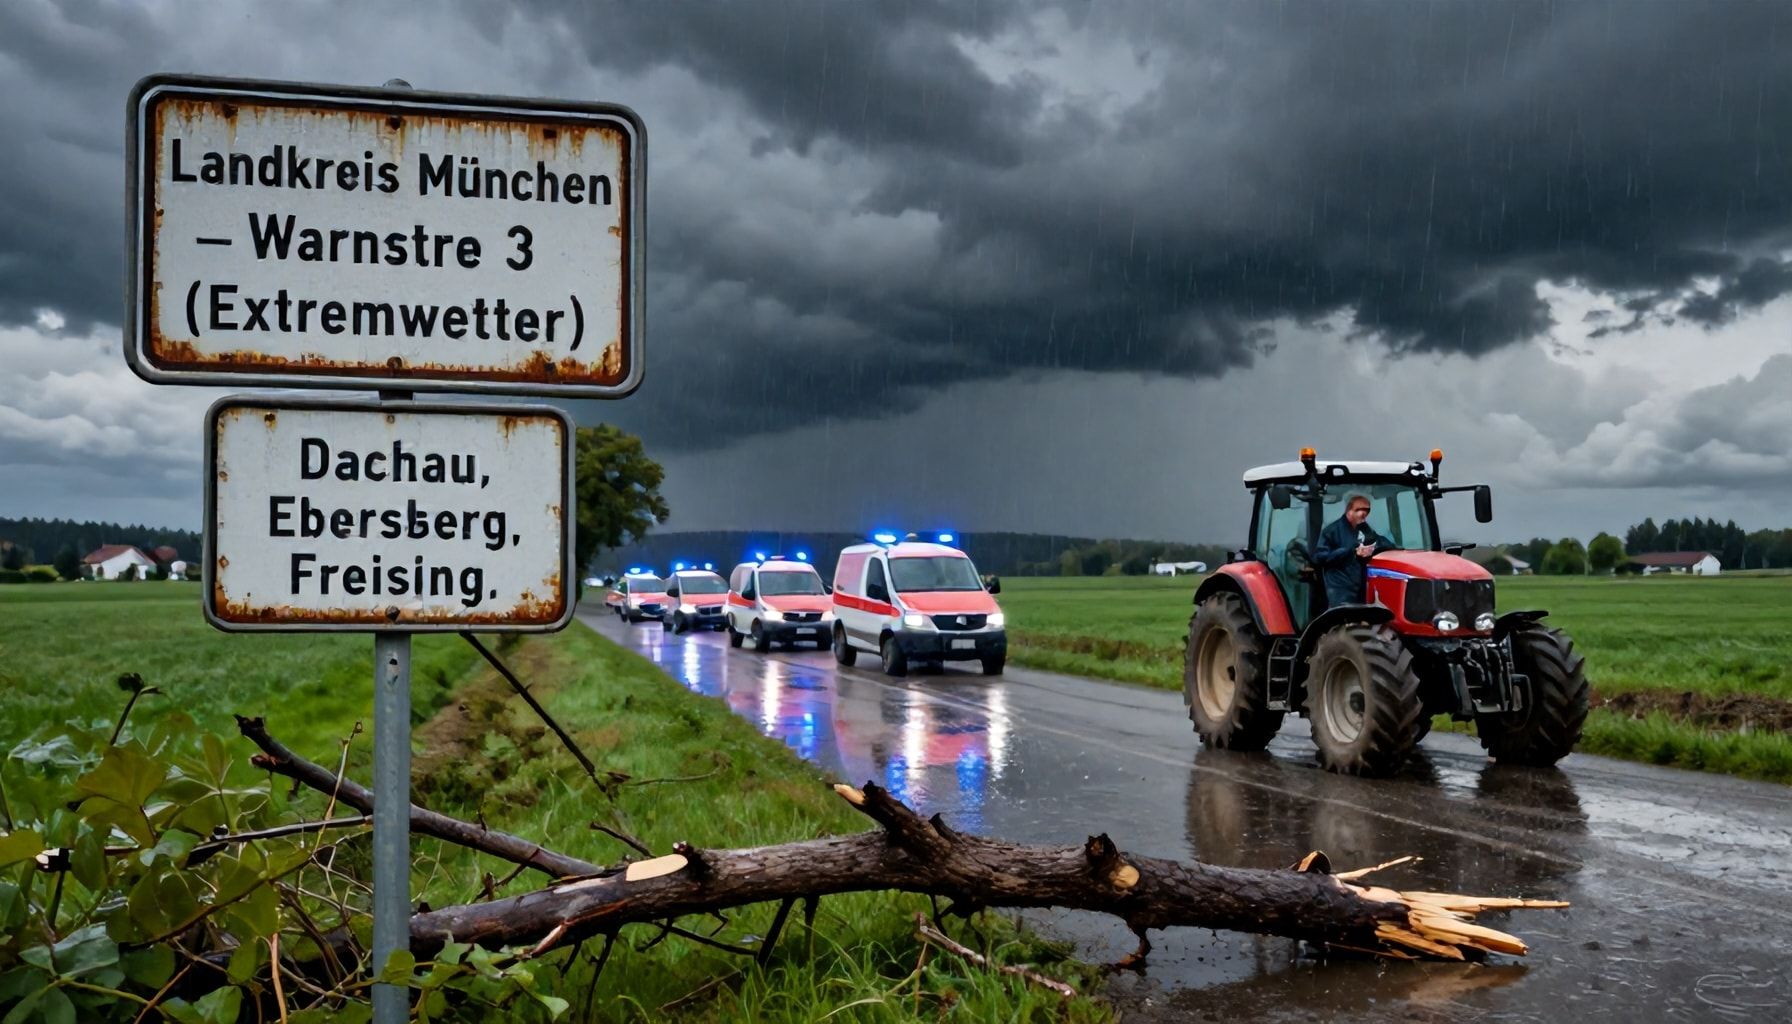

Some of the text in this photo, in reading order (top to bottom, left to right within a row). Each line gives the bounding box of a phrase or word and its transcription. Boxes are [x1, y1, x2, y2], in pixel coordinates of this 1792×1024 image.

[171, 138, 612, 206] Landkreis München
[248, 212, 482, 269] Warnstre
[506, 224, 534, 272] 3
[186, 280, 586, 352] (Extremwetter)
[300, 437, 490, 489] Dachau,
